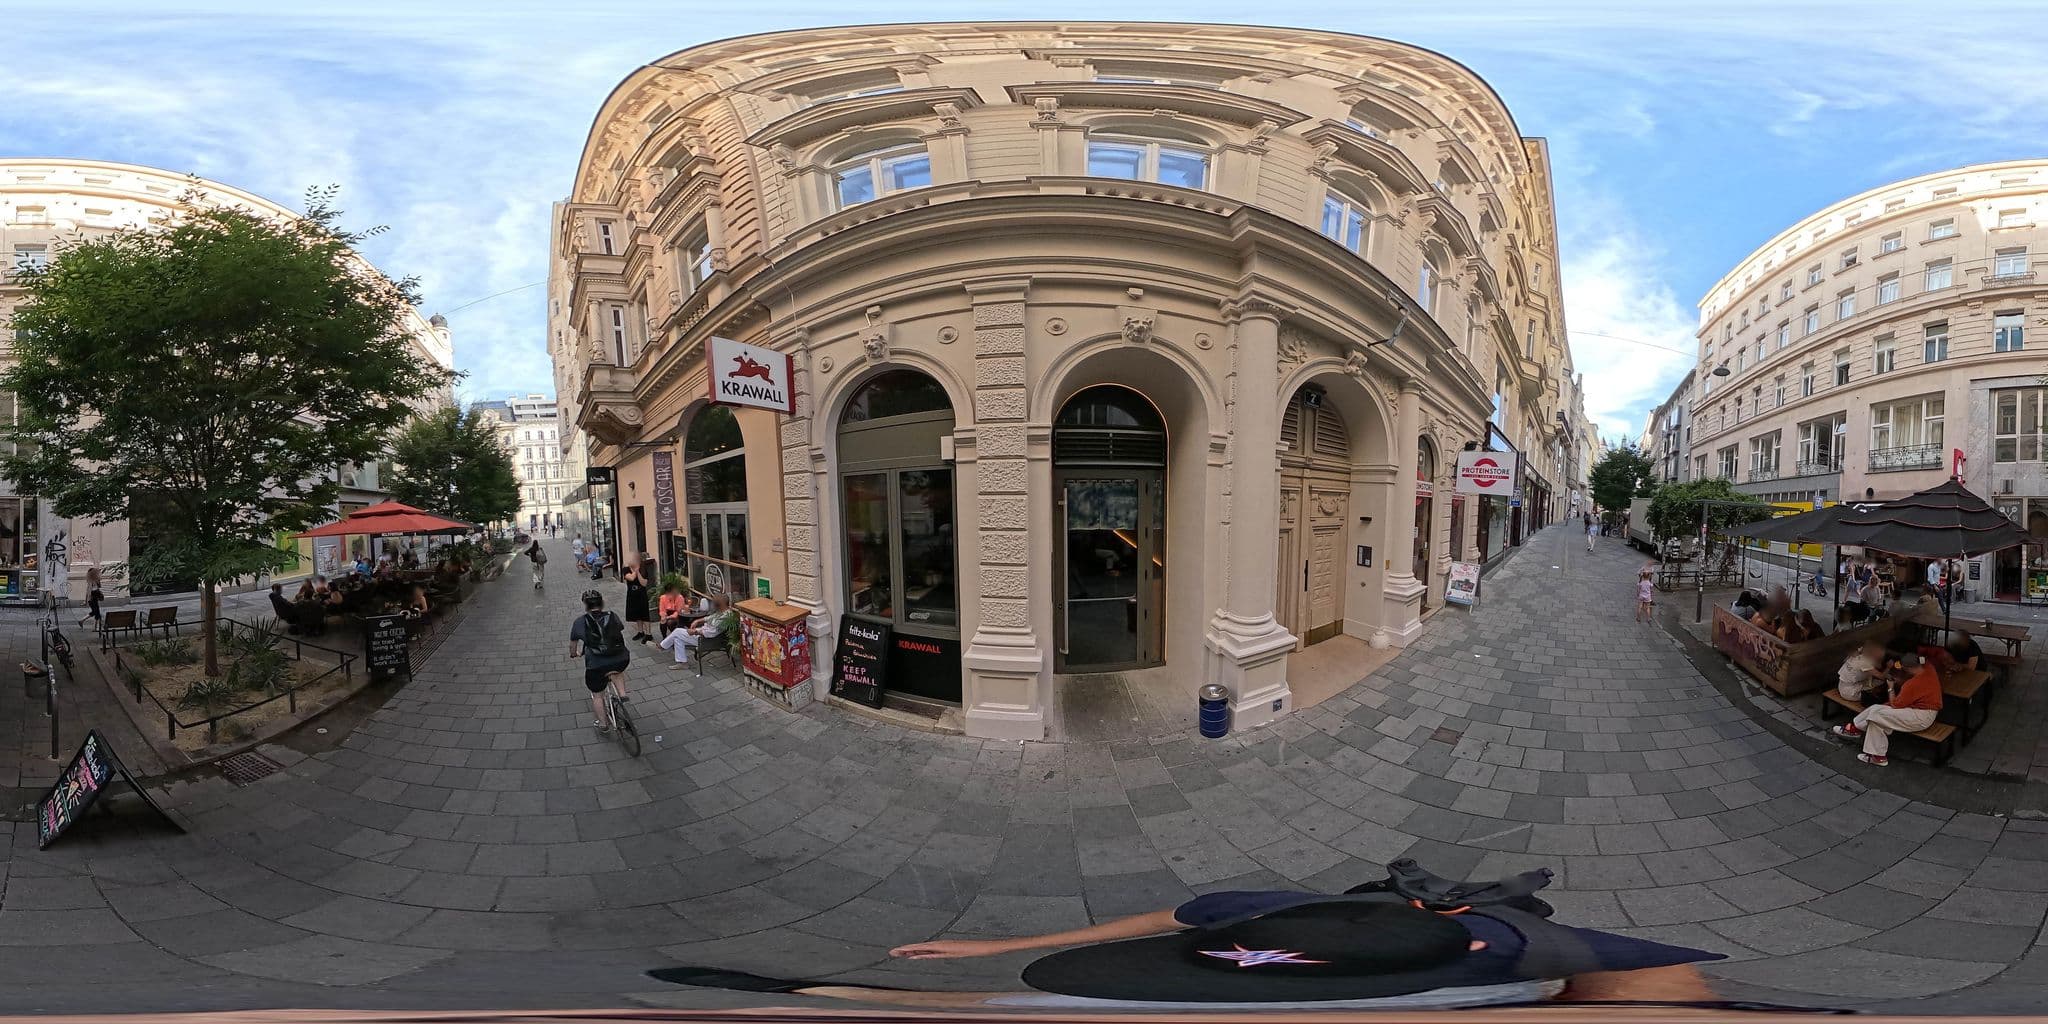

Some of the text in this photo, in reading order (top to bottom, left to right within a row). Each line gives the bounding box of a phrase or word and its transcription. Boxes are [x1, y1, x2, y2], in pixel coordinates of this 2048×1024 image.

[721, 380, 784, 404] KRAWALL
[1461, 467, 1510, 475] PROTEINSTORE
[656, 465, 674, 505] OSCAR
[849, 625, 879, 641] fritz-kola
[898, 640, 941, 654] KRAWALL
[843, 665, 866, 675] KEEP
[845, 675, 877, 687] KRAWALL
